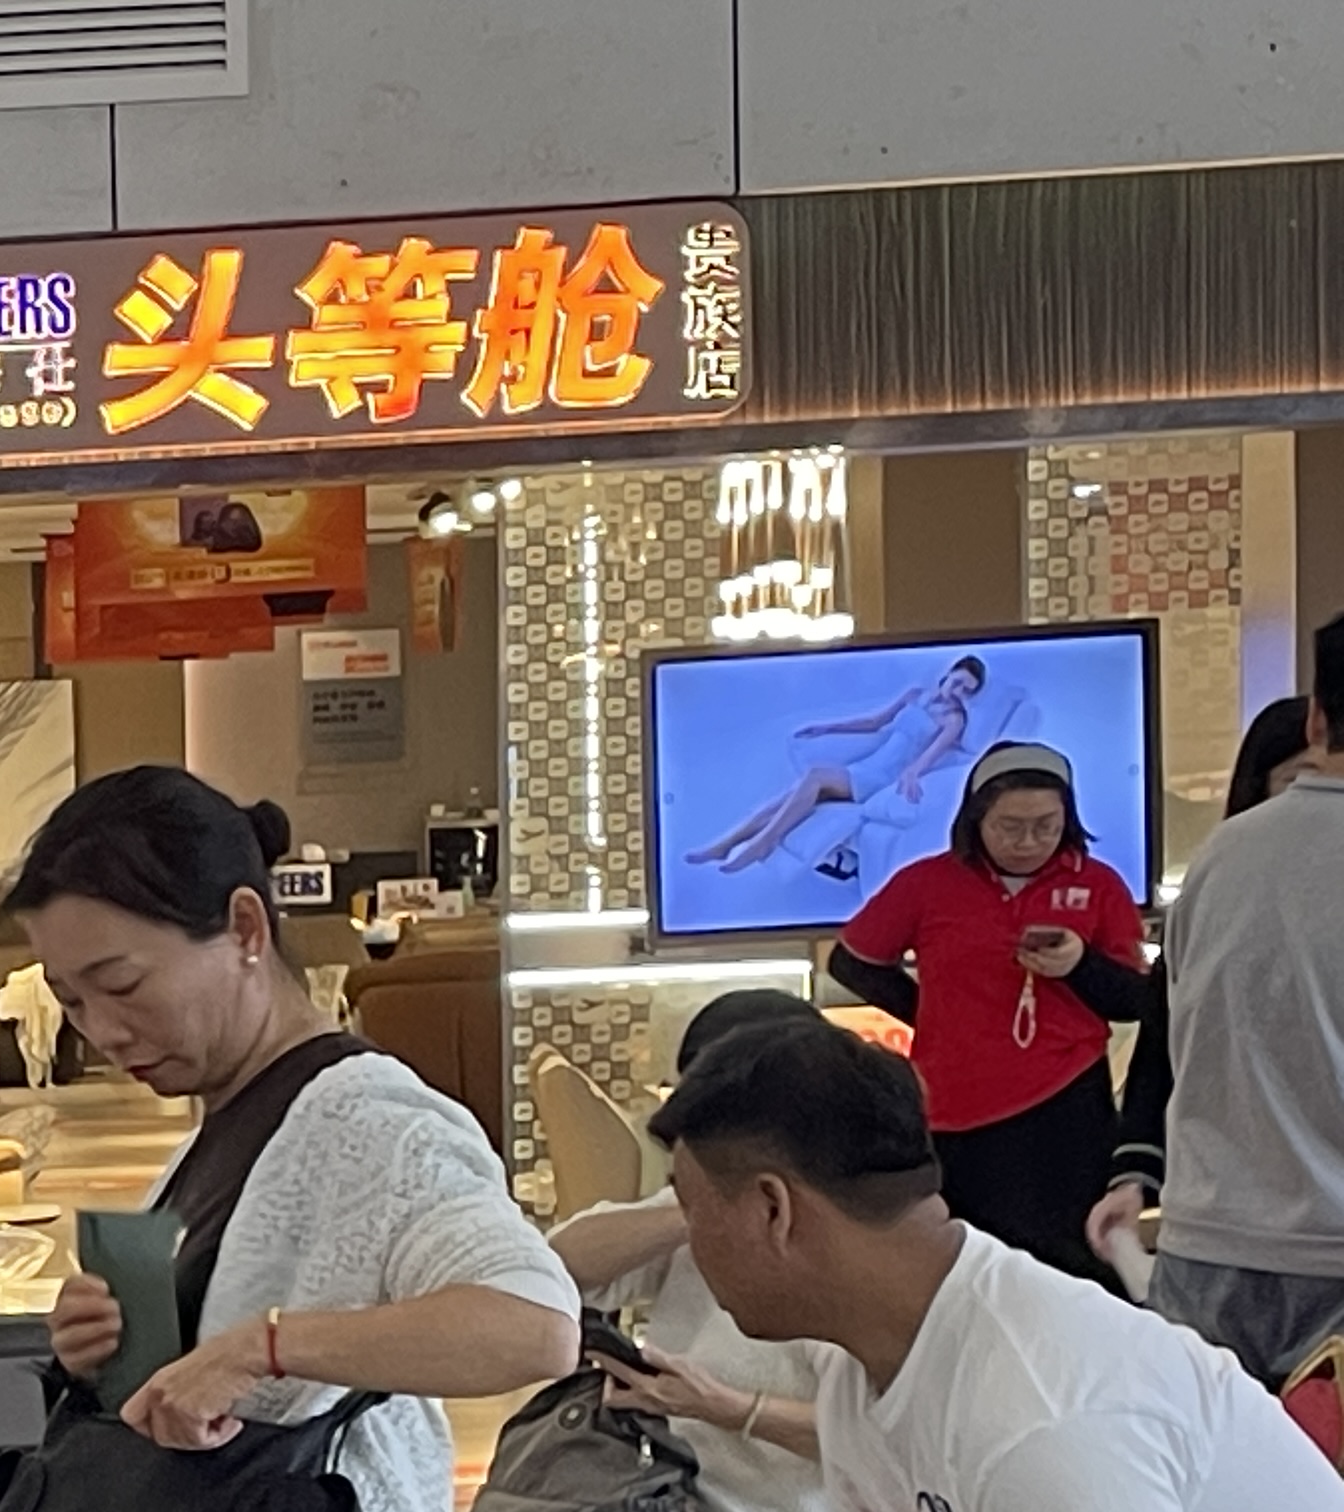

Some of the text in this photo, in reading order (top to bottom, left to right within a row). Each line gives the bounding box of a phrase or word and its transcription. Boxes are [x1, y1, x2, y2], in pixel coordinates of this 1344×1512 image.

[101, 222, 666, 435] 头等舱
[681, 222, 742, 400] 贵族店
